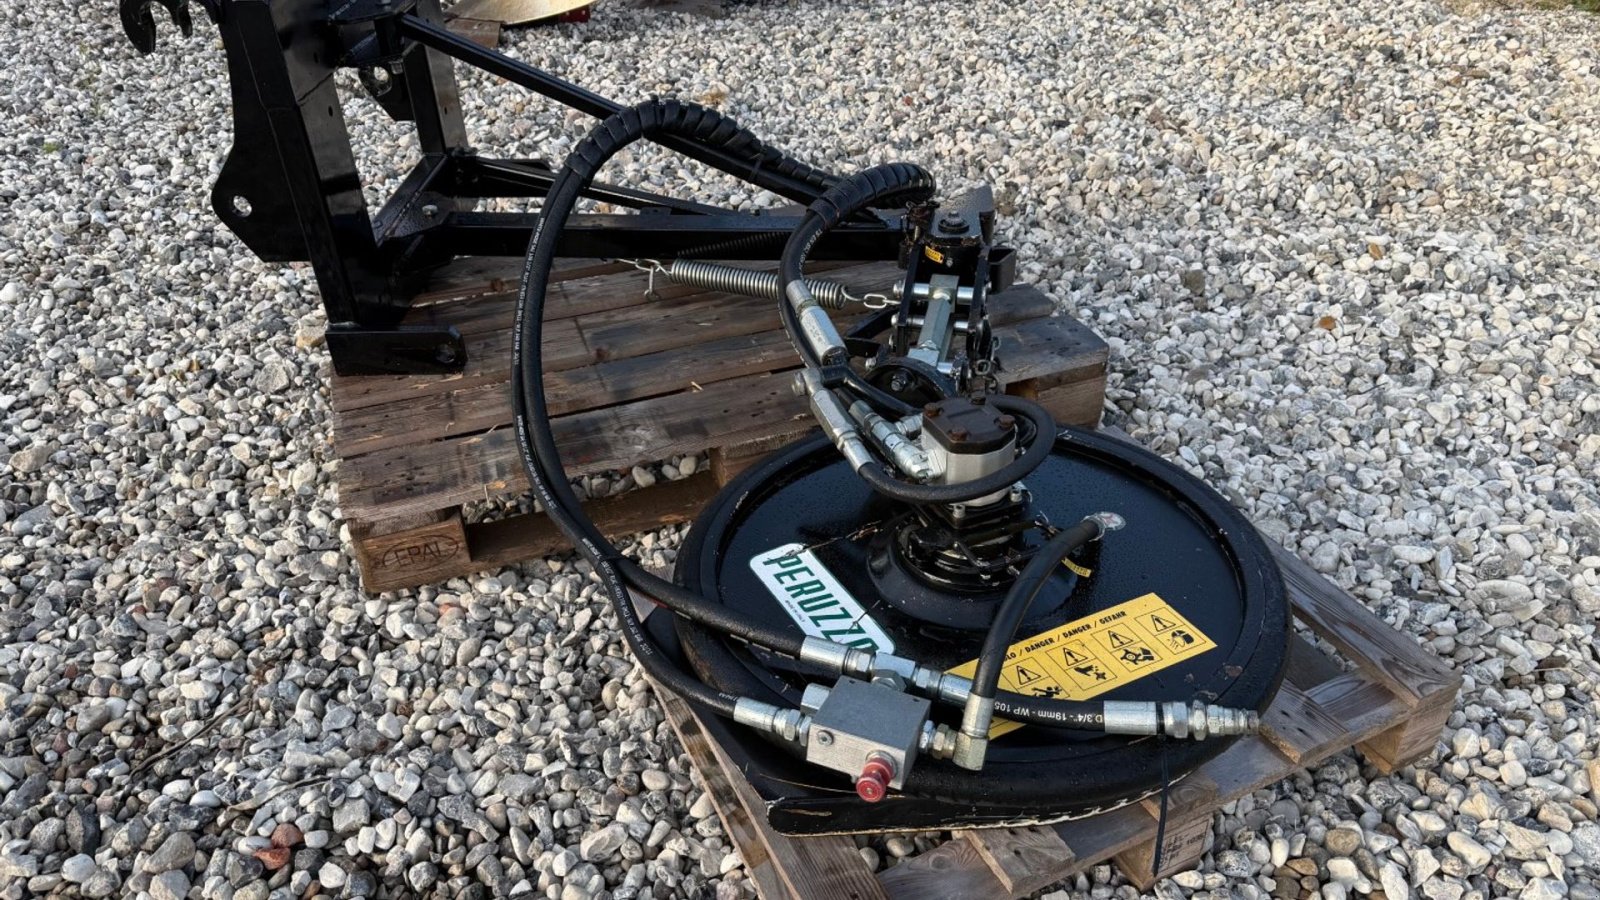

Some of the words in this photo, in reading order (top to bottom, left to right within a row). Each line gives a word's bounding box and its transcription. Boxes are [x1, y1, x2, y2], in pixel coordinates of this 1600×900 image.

[394, 540, 444, 567] EPAL
[1025, 638, 1055, 653] DANGER
[1062, 624, 1092, 638] DANGER
[1099, 611, 1127, 625] GEFAHR
[994, 702, 1011, 713] 105
[1013, 707, 1030, 717] WP
[1037, 710, 1067, 721] 19mm
